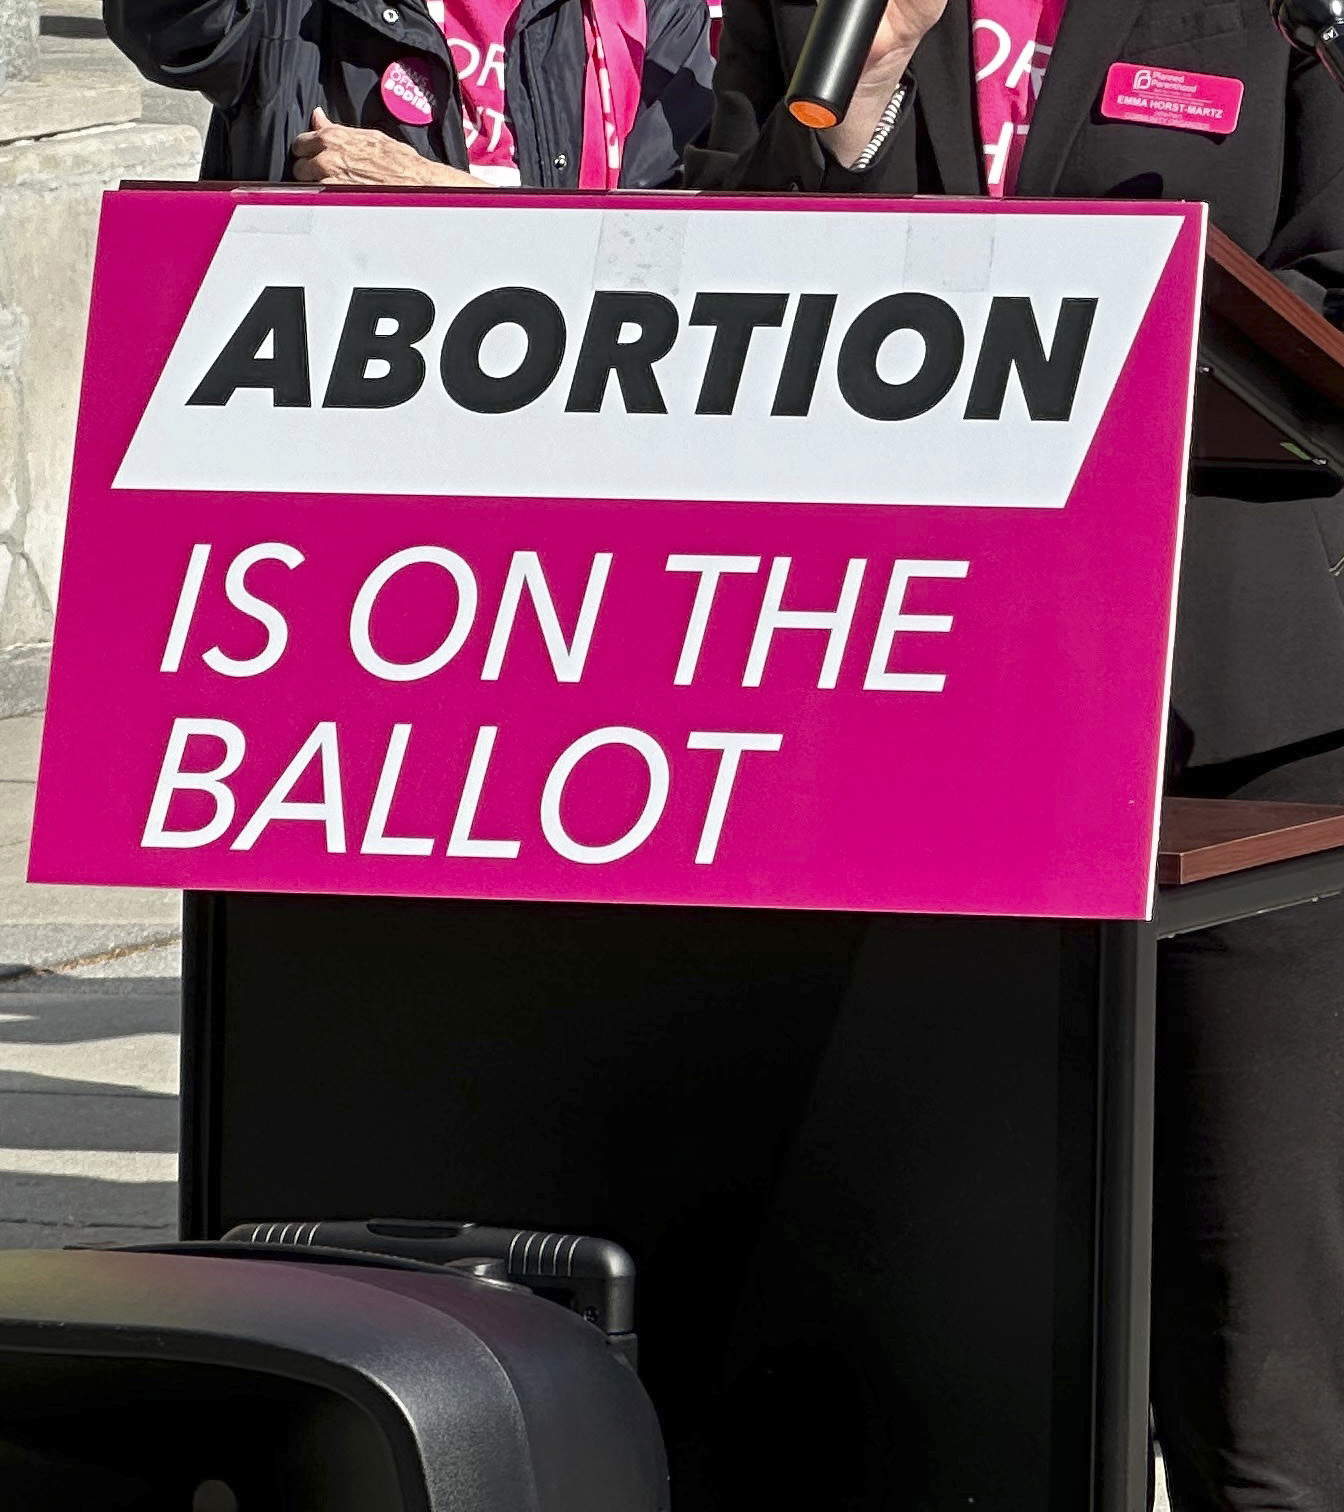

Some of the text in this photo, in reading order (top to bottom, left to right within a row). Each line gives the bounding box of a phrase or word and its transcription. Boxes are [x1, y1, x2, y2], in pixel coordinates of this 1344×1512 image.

[1117, 94, 1148, 108] EMMA
[1149, 100, 1224, 119] HORST-MARTZ
[1151, 71, 1185, 84] Planned
[1151, 78, 1198, 93] Parenthood
[184, 285, 1099, 422] ABORTION
[160, 542, 970, 693] IS ON THE
[140, 717, 784, 865] BALLOT
